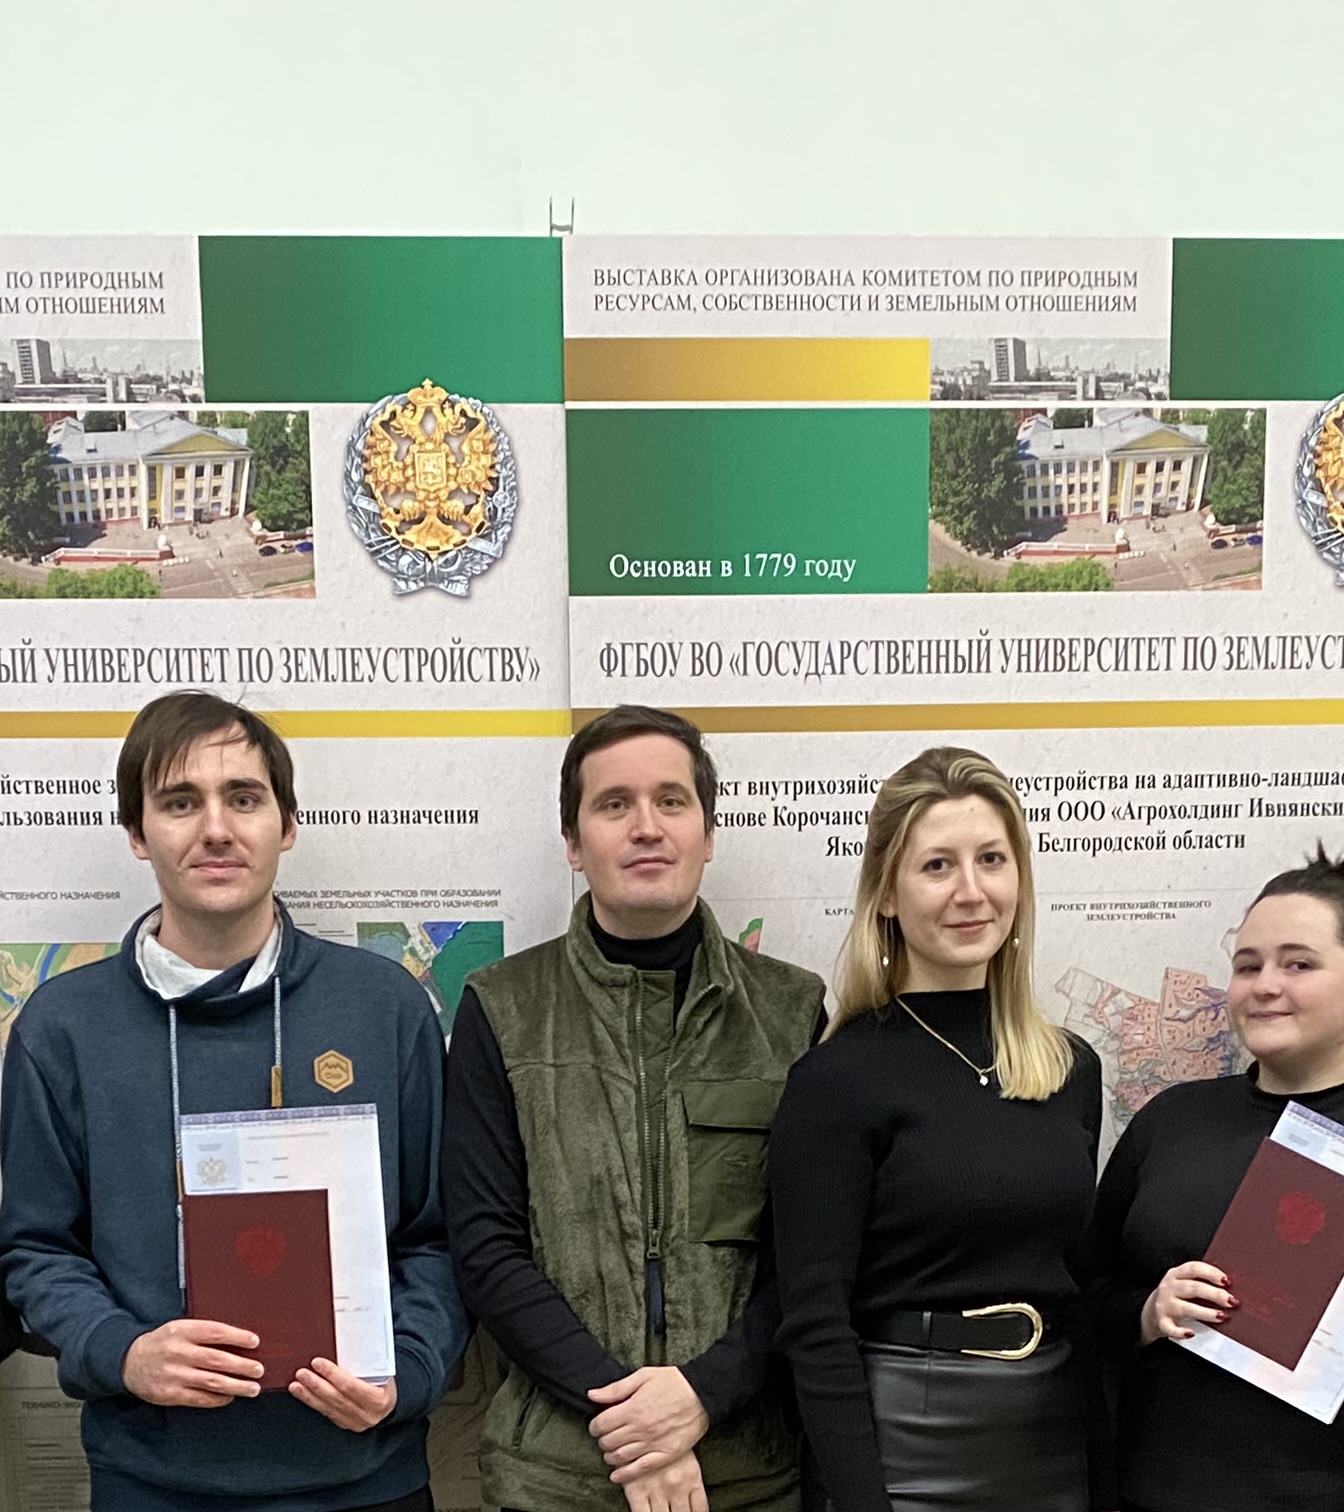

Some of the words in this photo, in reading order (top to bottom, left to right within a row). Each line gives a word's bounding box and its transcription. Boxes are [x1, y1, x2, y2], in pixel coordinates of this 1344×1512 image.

[6, 272, 33, 288] ПО
[40, 271, 163, 291] ПРИРОДНЫМ
[594, 268, 697, 286] ВЫСТАВКА
[705, 269, 854, 286] ОРГАНИЗОВАНА
[862, 269, 980, 286] КОМИТЕТОМ
[988, 270, 1013, 286] ПО
[1021, 270, 1137, 289] ПРИРОДНЫМ
[25, 297, 164, 313] ОТНОШЕНИЯМ
[595, 294, 696, 312] РЕСУРСАМ,
[702, 294, 860, 311] СОБСТВЕННОСТИ
[868, 294, 878, 310] И
[885, 294, 999, 311] ЗЕМЕЛЬНЫМ
[1005, 295, 1136, 312] ОТНОШЕНИЯМ
[609, 553, 711, 578] Основан
[721, 560, 732, 576] в
[744, 553, 795, 576] 1779
[805, 559, 855, 581] году
[43, 647, 229, 689] УНИВЕРСИТЕТ
[237, 647, 273, 683] ПО
[280, 640, 539, 684] ЗЕМЛЕУСТРОЙСТВУ»
[599, 641, 682, 678] ФГБОУ
[690, 641, 722, 677] ВО
[729, 634, 991, 682] «ГОСУДАРСТВЕННЫЙ
[1000, 636, 1176, 673] УНИВЕРСИТЕТ
[1182, 636, 1216, 671] ПО
[1016, 769, 1127, 795] еустройства
[1135, 774, 1155, 789] на
[297, 810, 360, 824] енного
[368, 809, 478, 824] назначения
[715, 812, 766, 828] снове
[1057, 800, 1105, 821] ООО
[1111, 799, 1241, 823] «Агрохолдинг
[1038, 830, 1165, 855] Белгородской
[1173, 829, 1244, 849] области
[60, 890, 120, 900] НАЗНАЧЕНИЯ
[374, 889, 418, 898] УЧАСТКОВ
[443, 899, 499, 909] НАЗНАЧЕНИЯ
